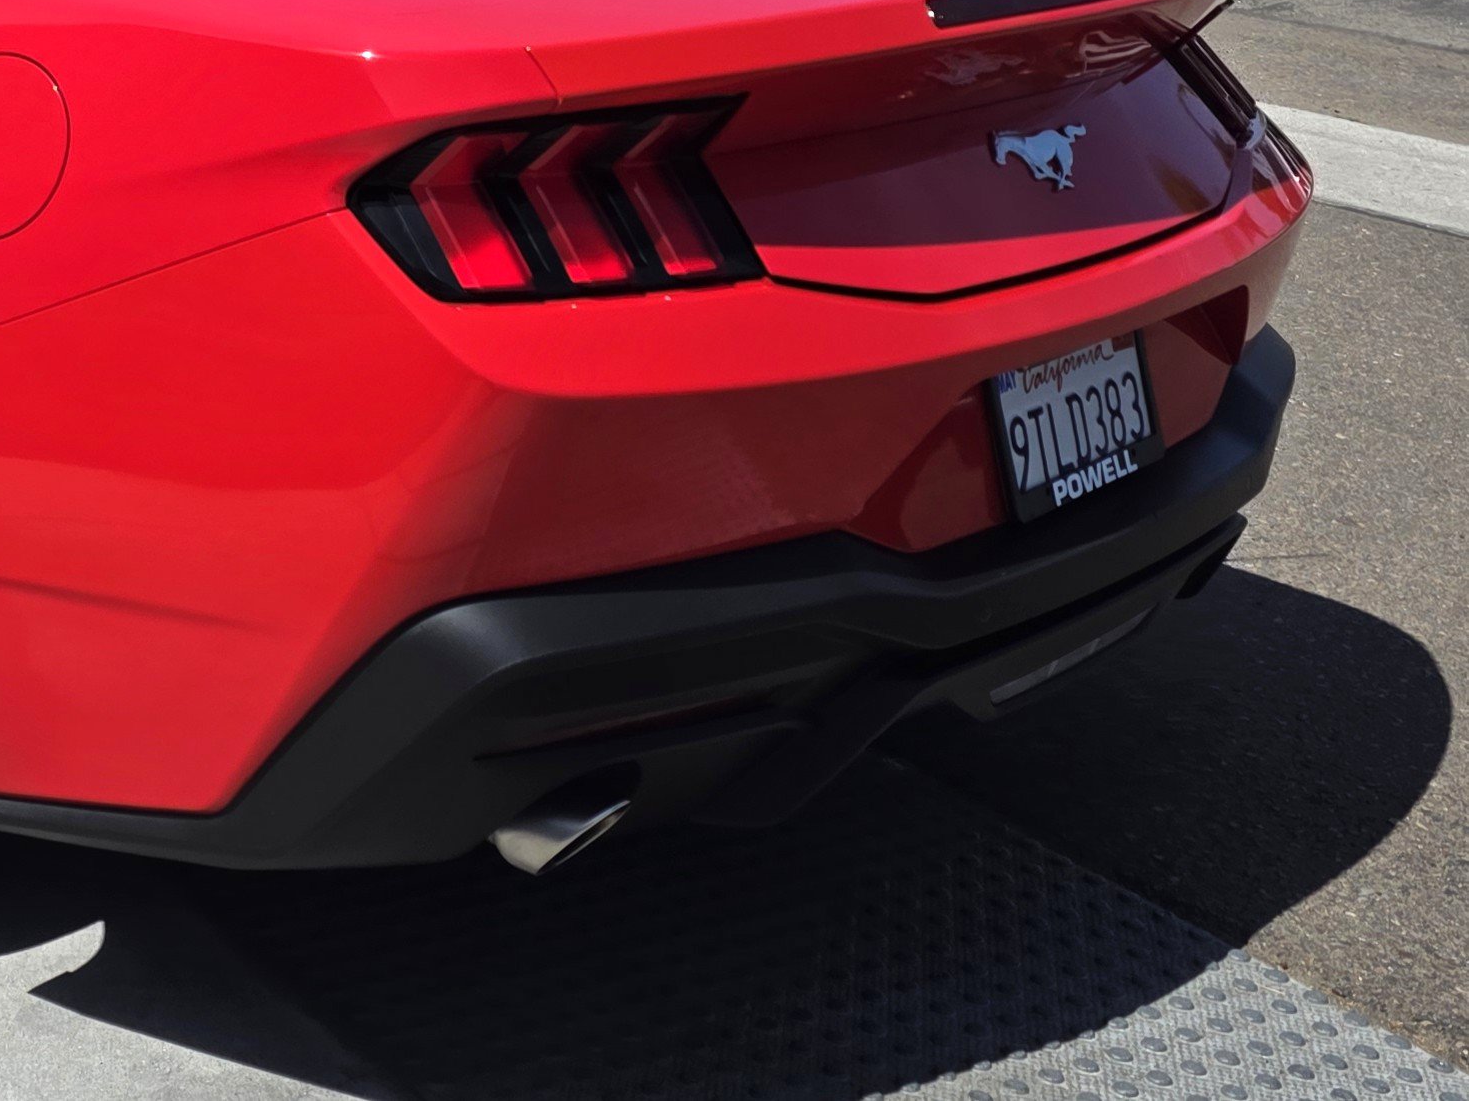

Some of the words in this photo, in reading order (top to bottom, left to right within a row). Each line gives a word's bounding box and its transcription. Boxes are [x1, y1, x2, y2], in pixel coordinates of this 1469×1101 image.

[1018, 343, 1115, 394] California
[1009, 370, 1145, 495] 9TLD383
[1052, 449, 1139, 508] POWELL
